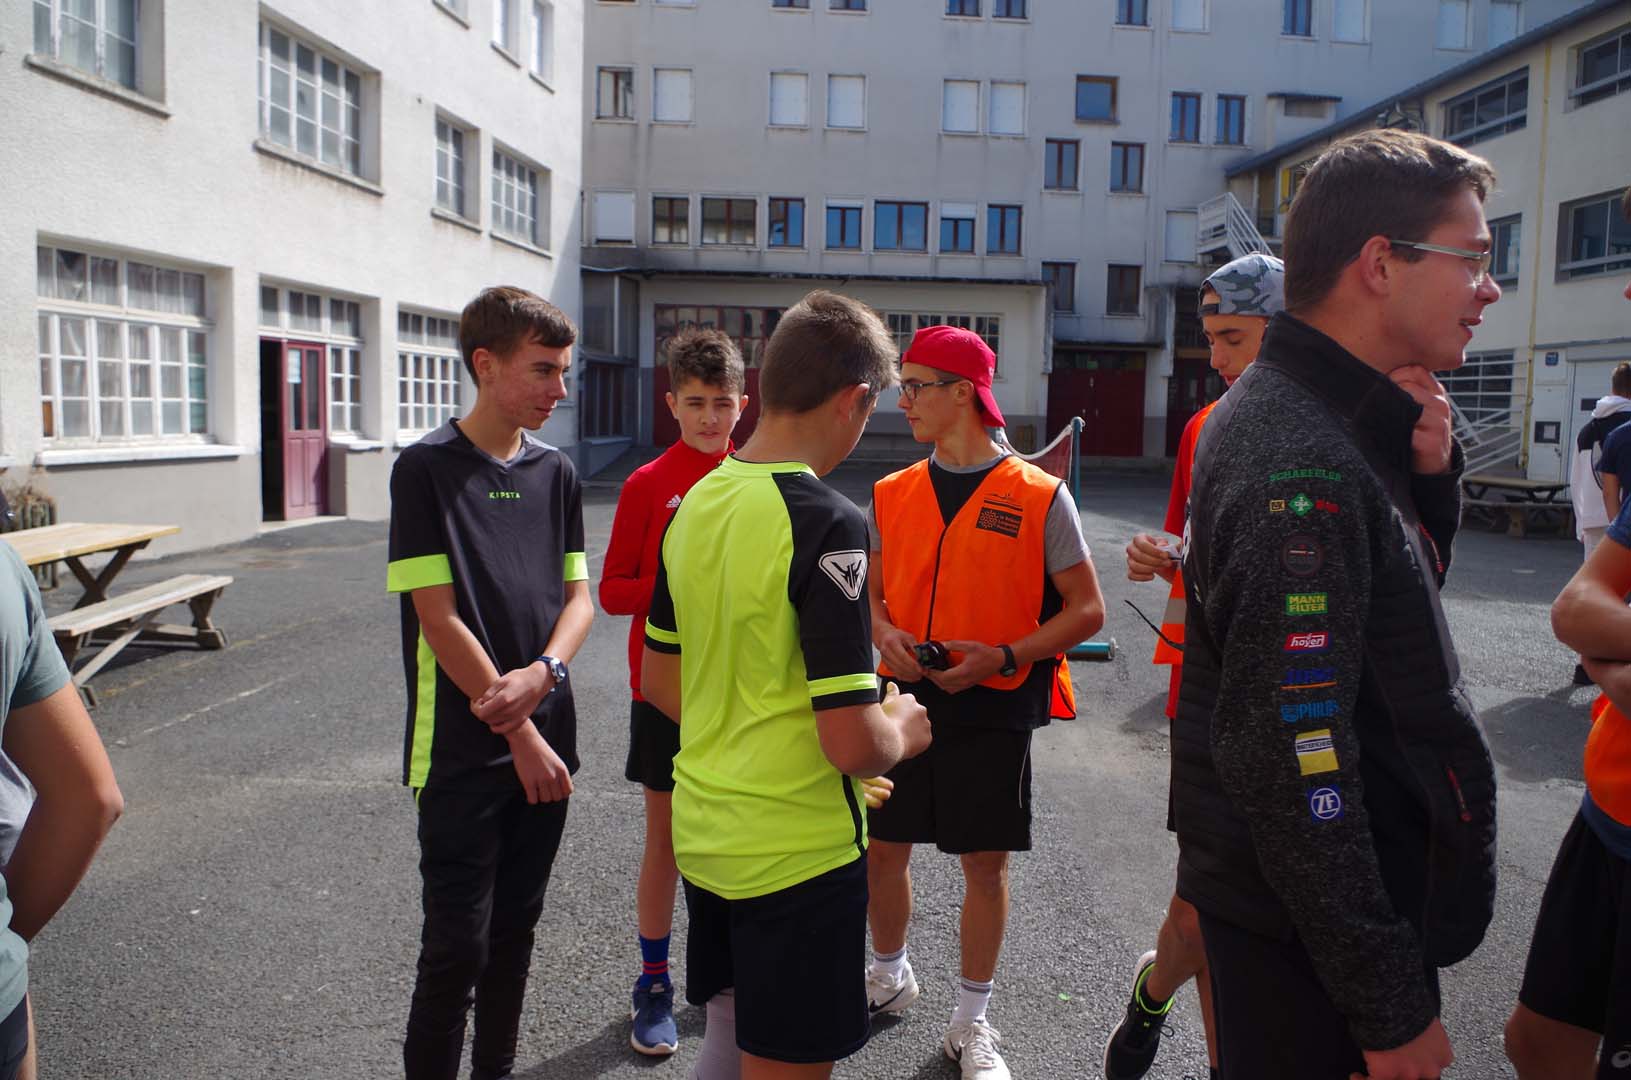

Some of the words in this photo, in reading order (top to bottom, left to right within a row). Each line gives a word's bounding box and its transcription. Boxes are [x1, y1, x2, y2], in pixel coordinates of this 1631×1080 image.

[489, 491, 520, 499] KIPSTA
[1289, 595, 1326, 604] MANN
[1289, 604, 1326, 613] FILTER
[1290, 634, 1325, 648] hoyer
[1313, 793, 1339, 814] ZF
